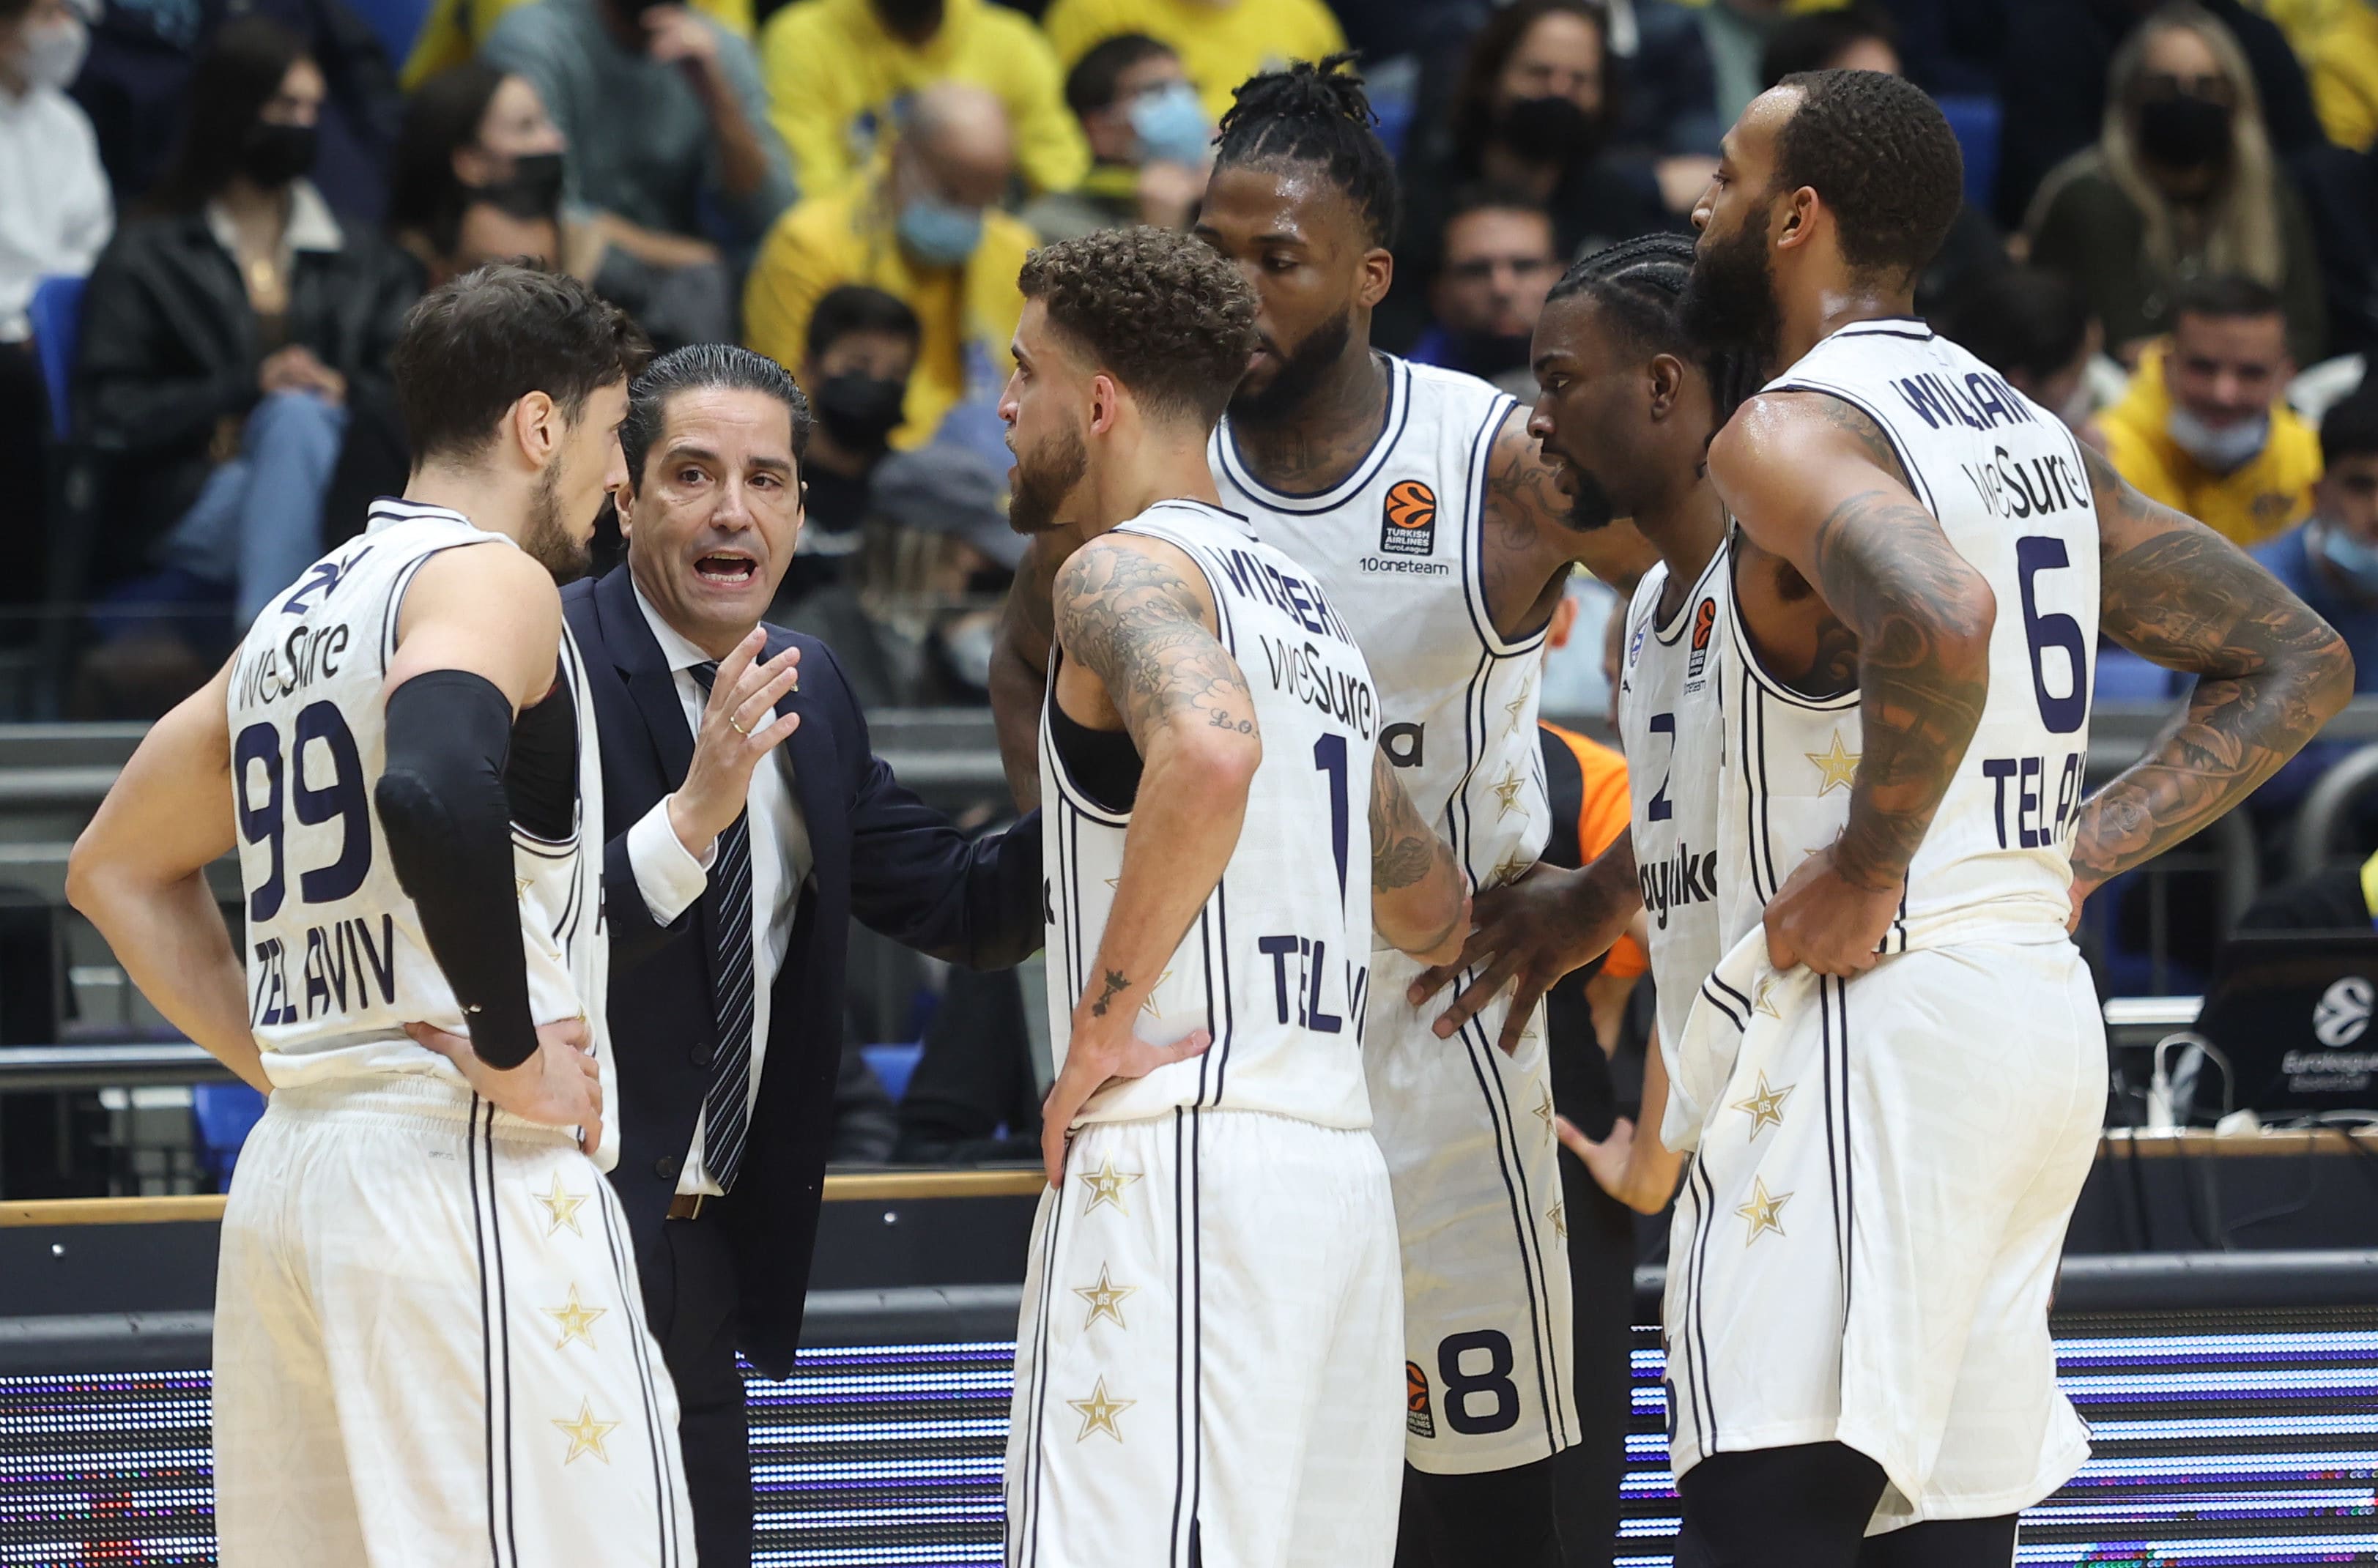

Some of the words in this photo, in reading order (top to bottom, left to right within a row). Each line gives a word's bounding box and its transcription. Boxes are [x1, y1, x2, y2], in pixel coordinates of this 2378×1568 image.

[1961, 445, 2089, 519] weSure
[1384, 543, 1429, 554] EuroLeague
[1385, 536, 1430, 547] AIRLINES
[1387, 527, 1430, 539] TURKISH
[239, 623, 349, 711] weSure
[2016, 535, 2087, 734] 6
[1259, 633, 1371, 741] weSure
[234, 699, 372, 923] 99
[1314, 732, 1349, 933] 1
[304, 913, 396, 1020] AVIV
[1258, 934, 1343, 1034] TEL
[1758, 1099, 1771, 1115] 05
[1758, 1206, 1771, 1220] 14
[1097, 1293, 1111, 1305] 05
[1095, 1406, 1105, 1420] 14
[1437, 1329, 1520, 1435] 8
